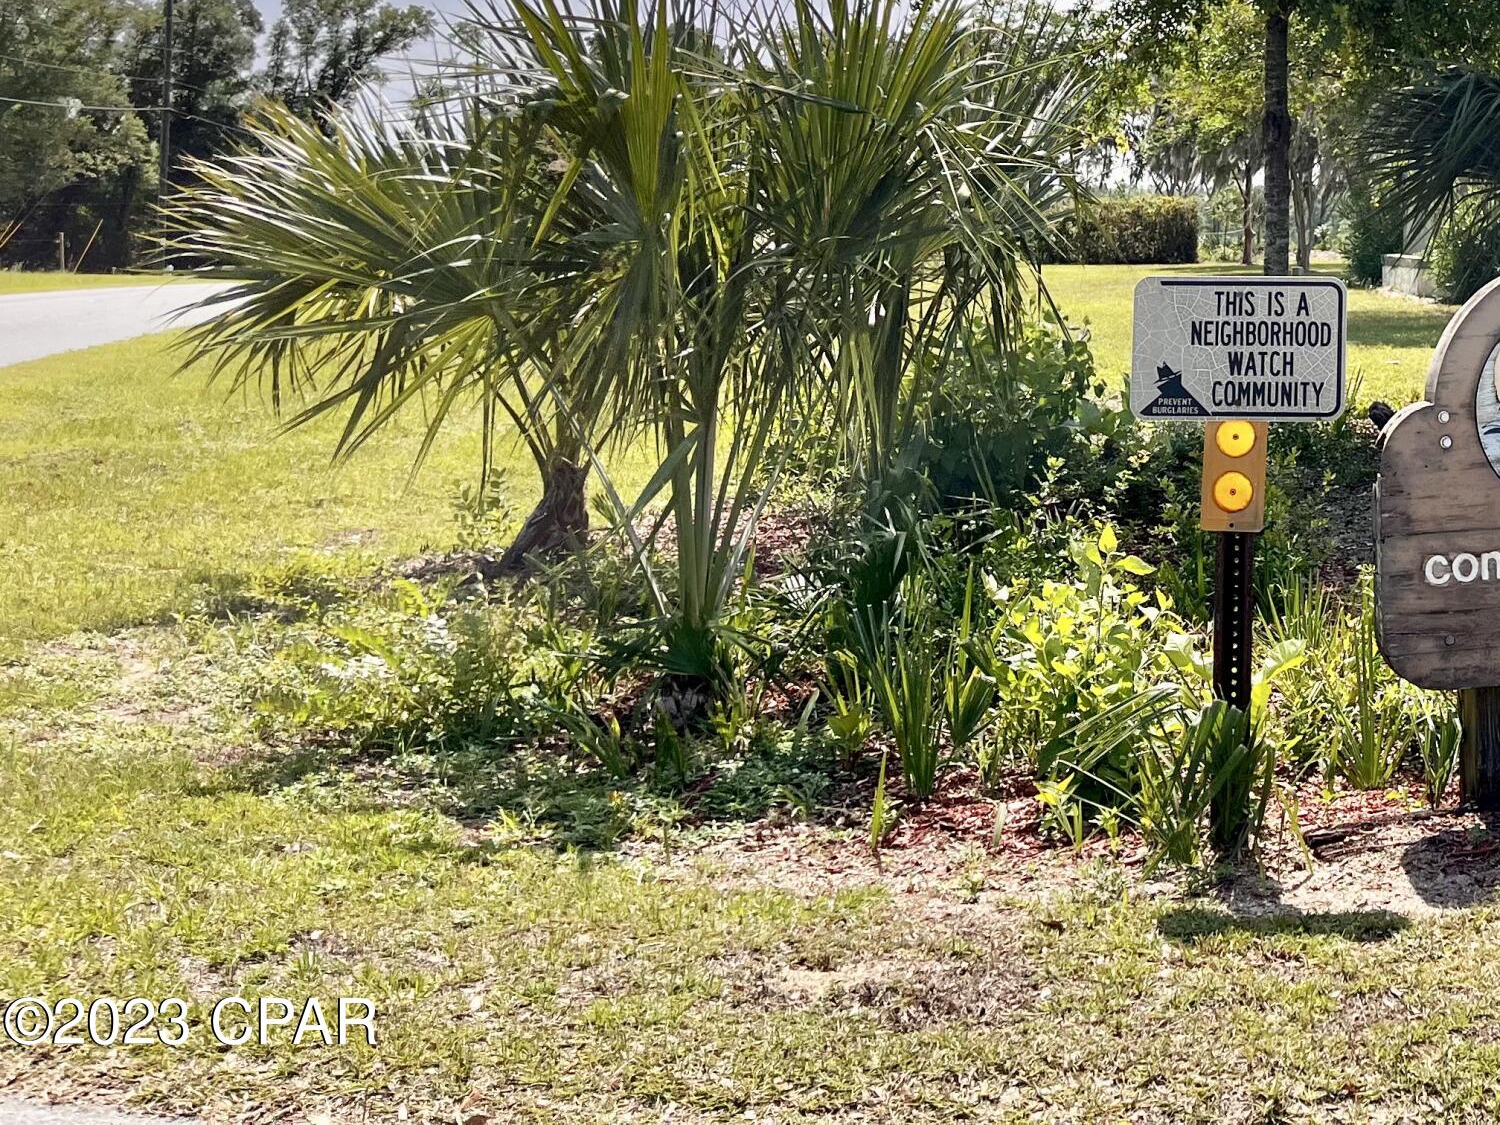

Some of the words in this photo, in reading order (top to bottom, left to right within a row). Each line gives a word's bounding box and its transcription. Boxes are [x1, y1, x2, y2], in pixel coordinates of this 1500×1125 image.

[1214, 291, 1255, 317] THIS
[1267, 291, 1285, 317] IS
[1296, 291, 1310, 317] A
[1190, 321, 1332, 347] NEIGHBORHOOD
[1227, 351, 1294, 377] WATCH
[1157, 397, 1193, 406] PREVENT
[1211, 381, 1324, 407] COMMUNITY
[1152, 406, 1199, 415] BURGLARIES
